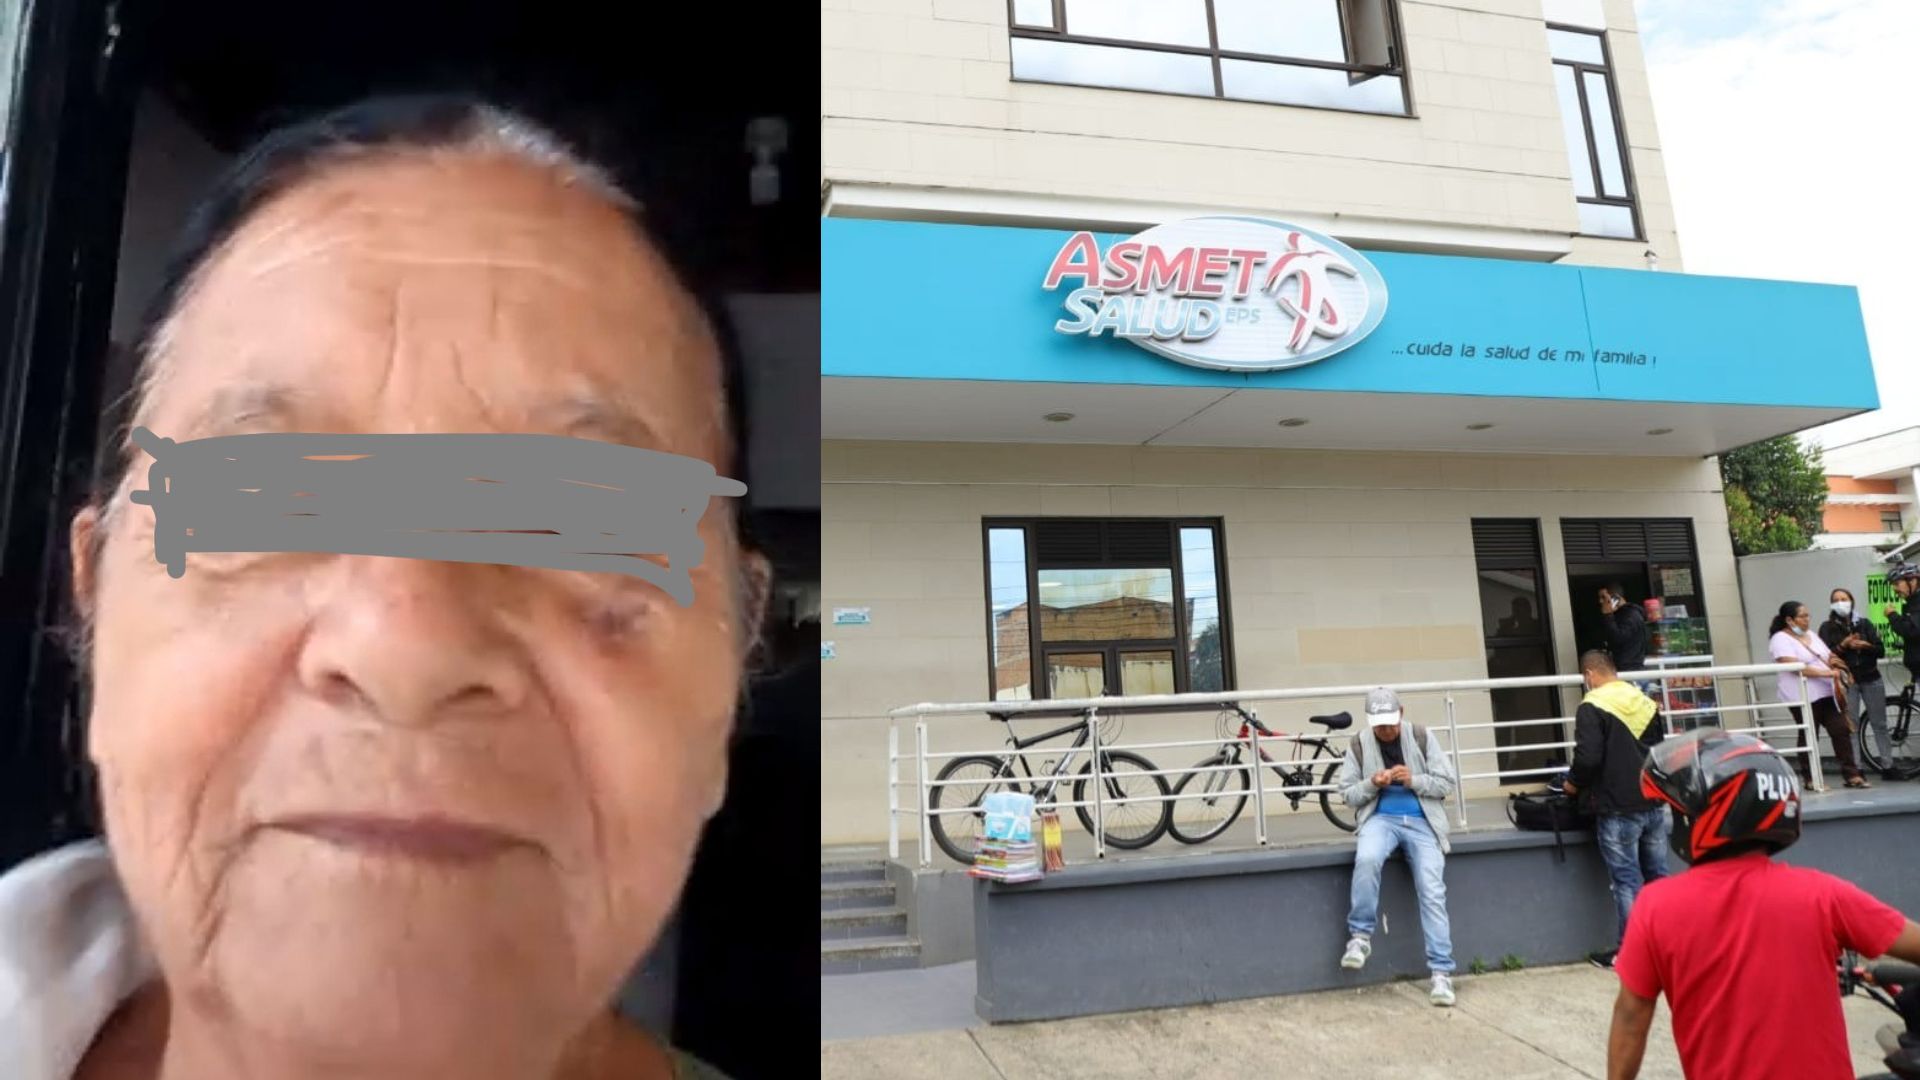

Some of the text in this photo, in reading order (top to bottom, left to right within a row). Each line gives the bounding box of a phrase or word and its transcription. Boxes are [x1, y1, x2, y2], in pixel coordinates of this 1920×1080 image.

[1043, 231, 1267, 299] ASMET
[1054, 287, 1261, 341] SALUD EPS
[1460, 343, 1476, 358] la
[1484, 345, 1530, 360] salud
[1537, 347, 1557, 361] de
[1564, 350, 1585, 362] mi
